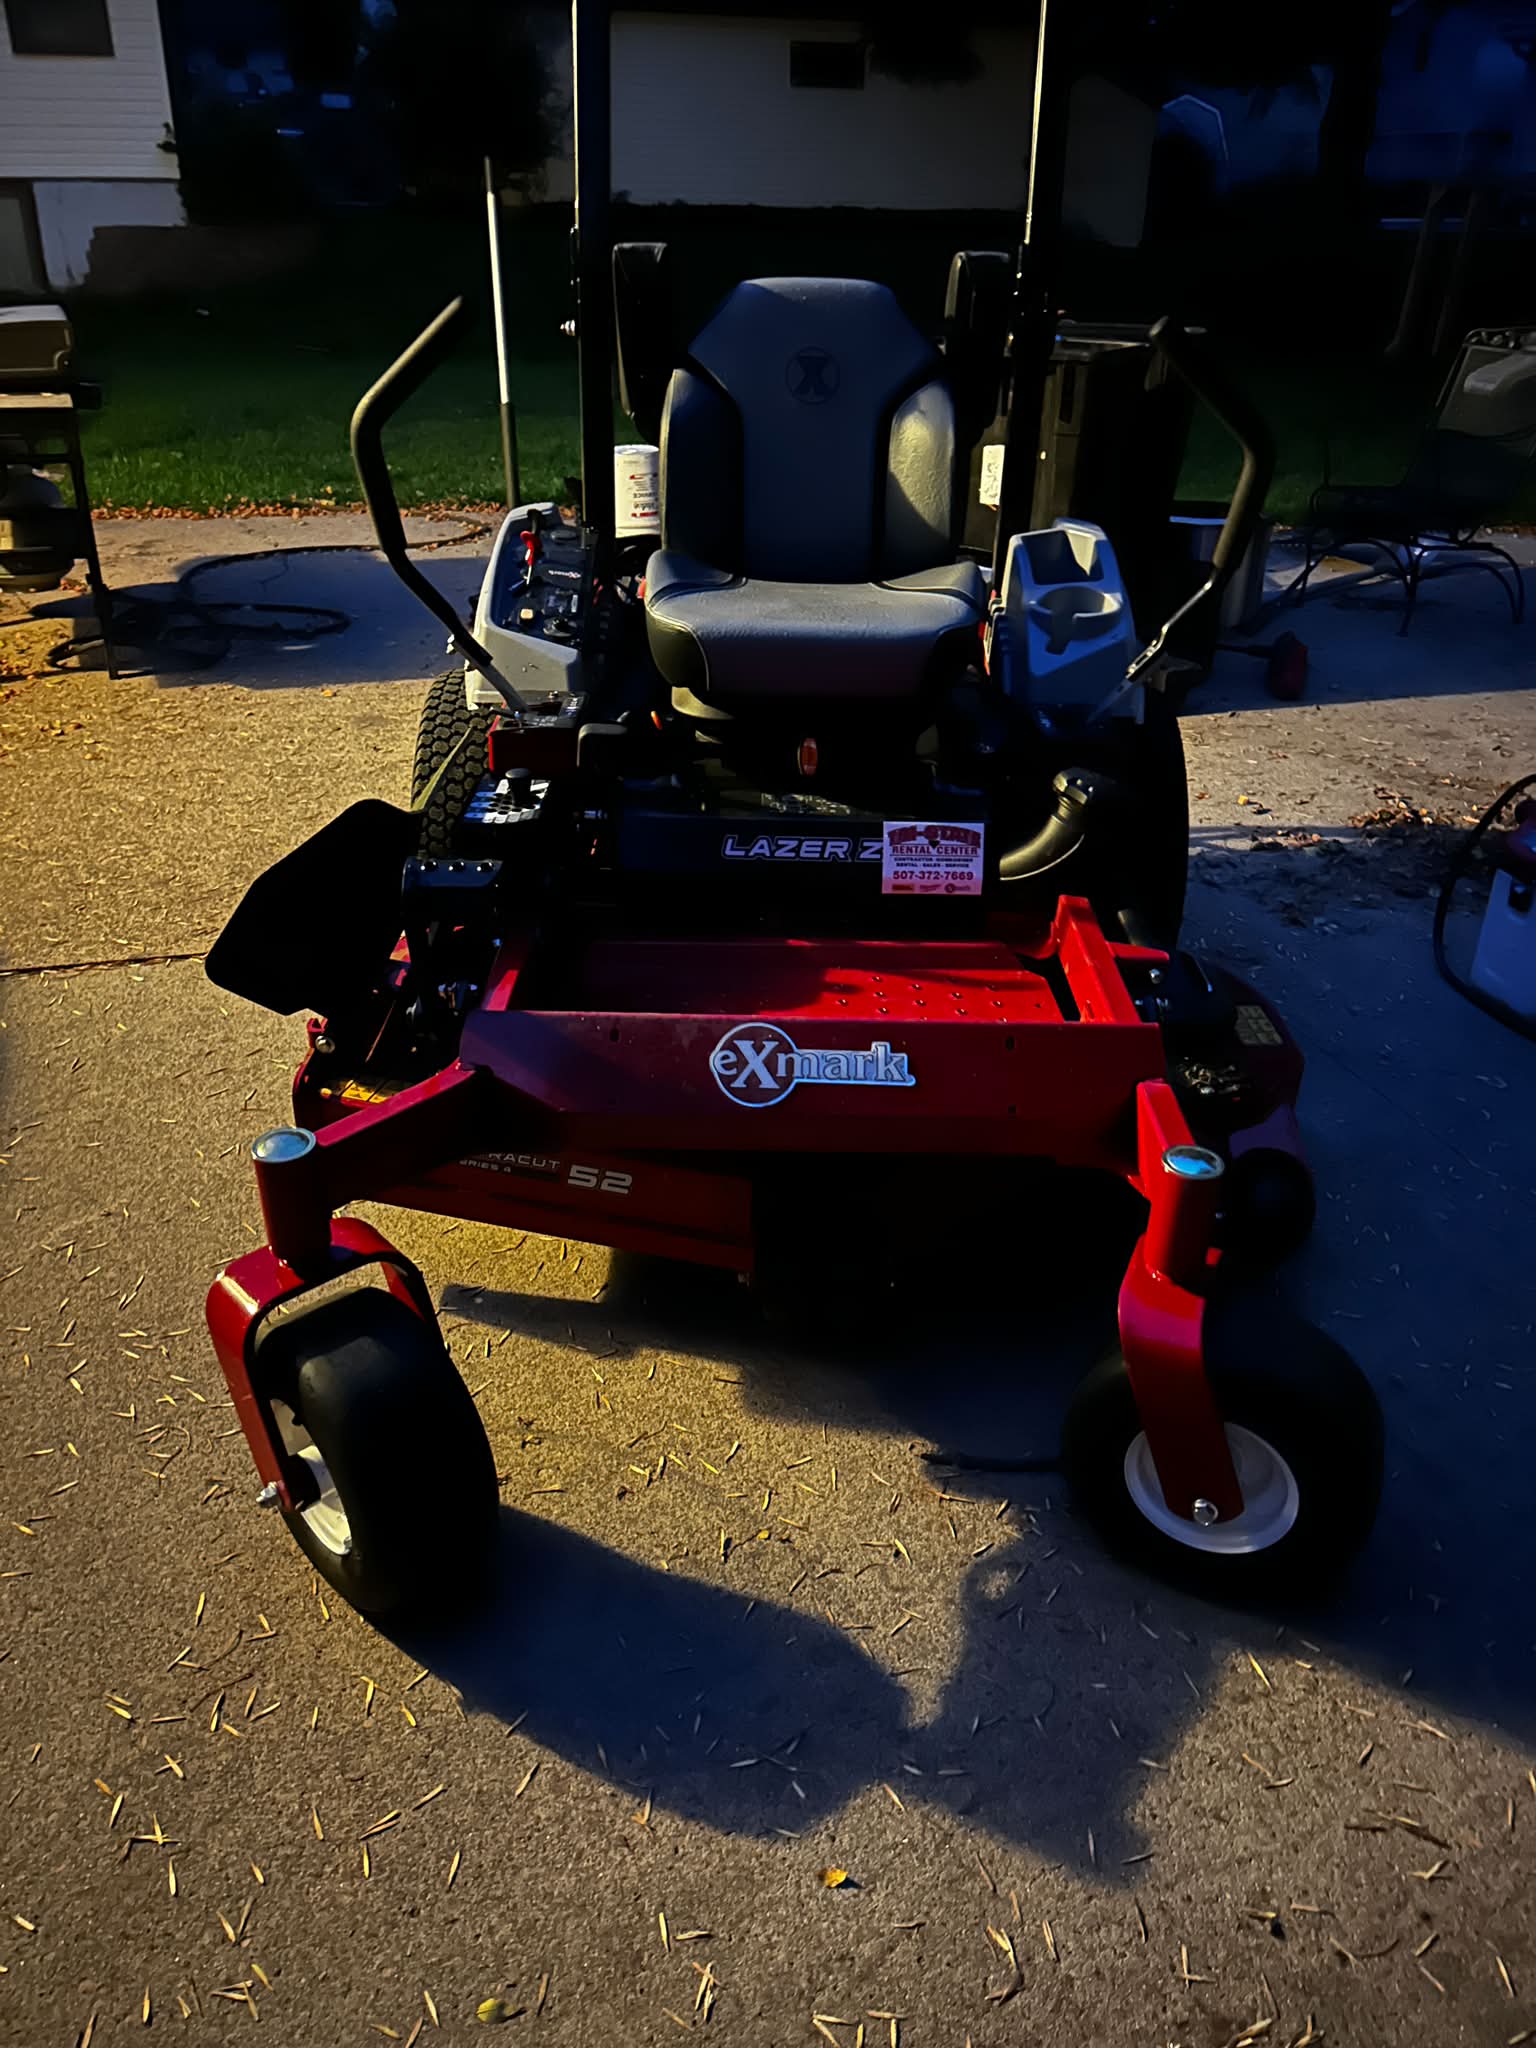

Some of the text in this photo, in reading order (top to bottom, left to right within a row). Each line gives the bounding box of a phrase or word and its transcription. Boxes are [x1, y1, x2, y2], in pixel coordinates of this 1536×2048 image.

[724, 837, 882, 860] LAZER Z
[892, 846, 978, 855] RENTAL CENTER
[893, 870, 974, 881] 507-372-7669
[711, 1035, 909, 1093] eXmark
[566, 1164, 633, 1195] 52
